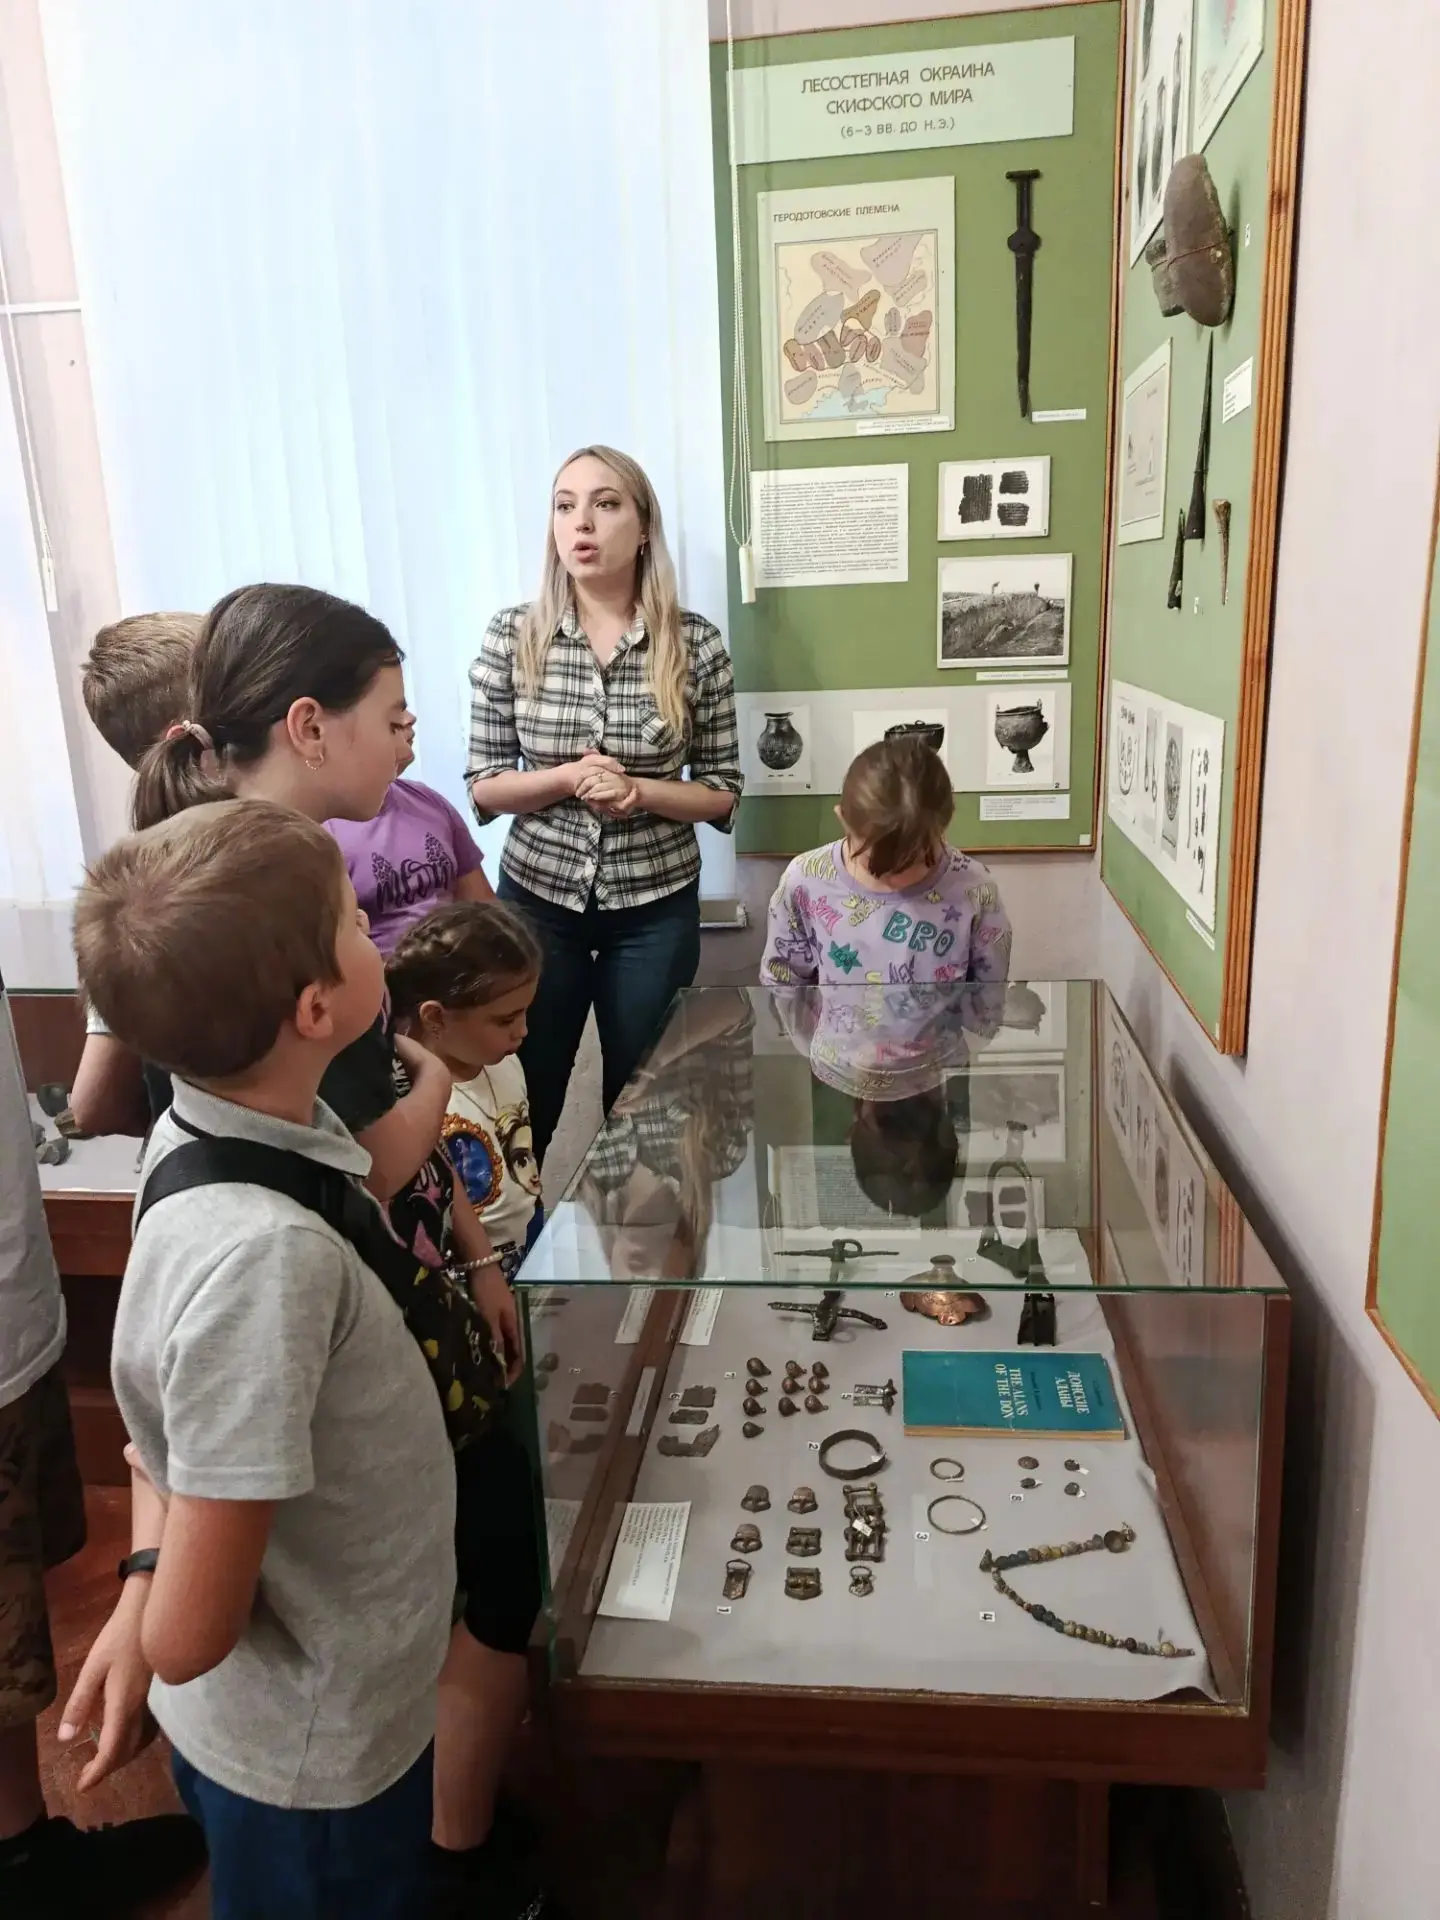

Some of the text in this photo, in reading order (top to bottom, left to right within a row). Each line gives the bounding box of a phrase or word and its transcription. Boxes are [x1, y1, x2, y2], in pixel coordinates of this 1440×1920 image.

[801, 61, 996, 94] ЛЕСОСТЕПНАЯ ОКРАИНА
[826, 88, 974, 115] СКИФСКОГО МИРА
[900, 120, 918, 134] ДО
[773, 203, 901, 223] ГЕРОДОТОВСКИЕ ПЛЕМЕНА
[882, 909, 956, 958] BRO
[993, 1363, 1015, 1419] OF THE DON
[1009, 1367, 1029, 1417] THE ALANS
[1067, 1369, 1090, 1416] ДОНСКИЕ
